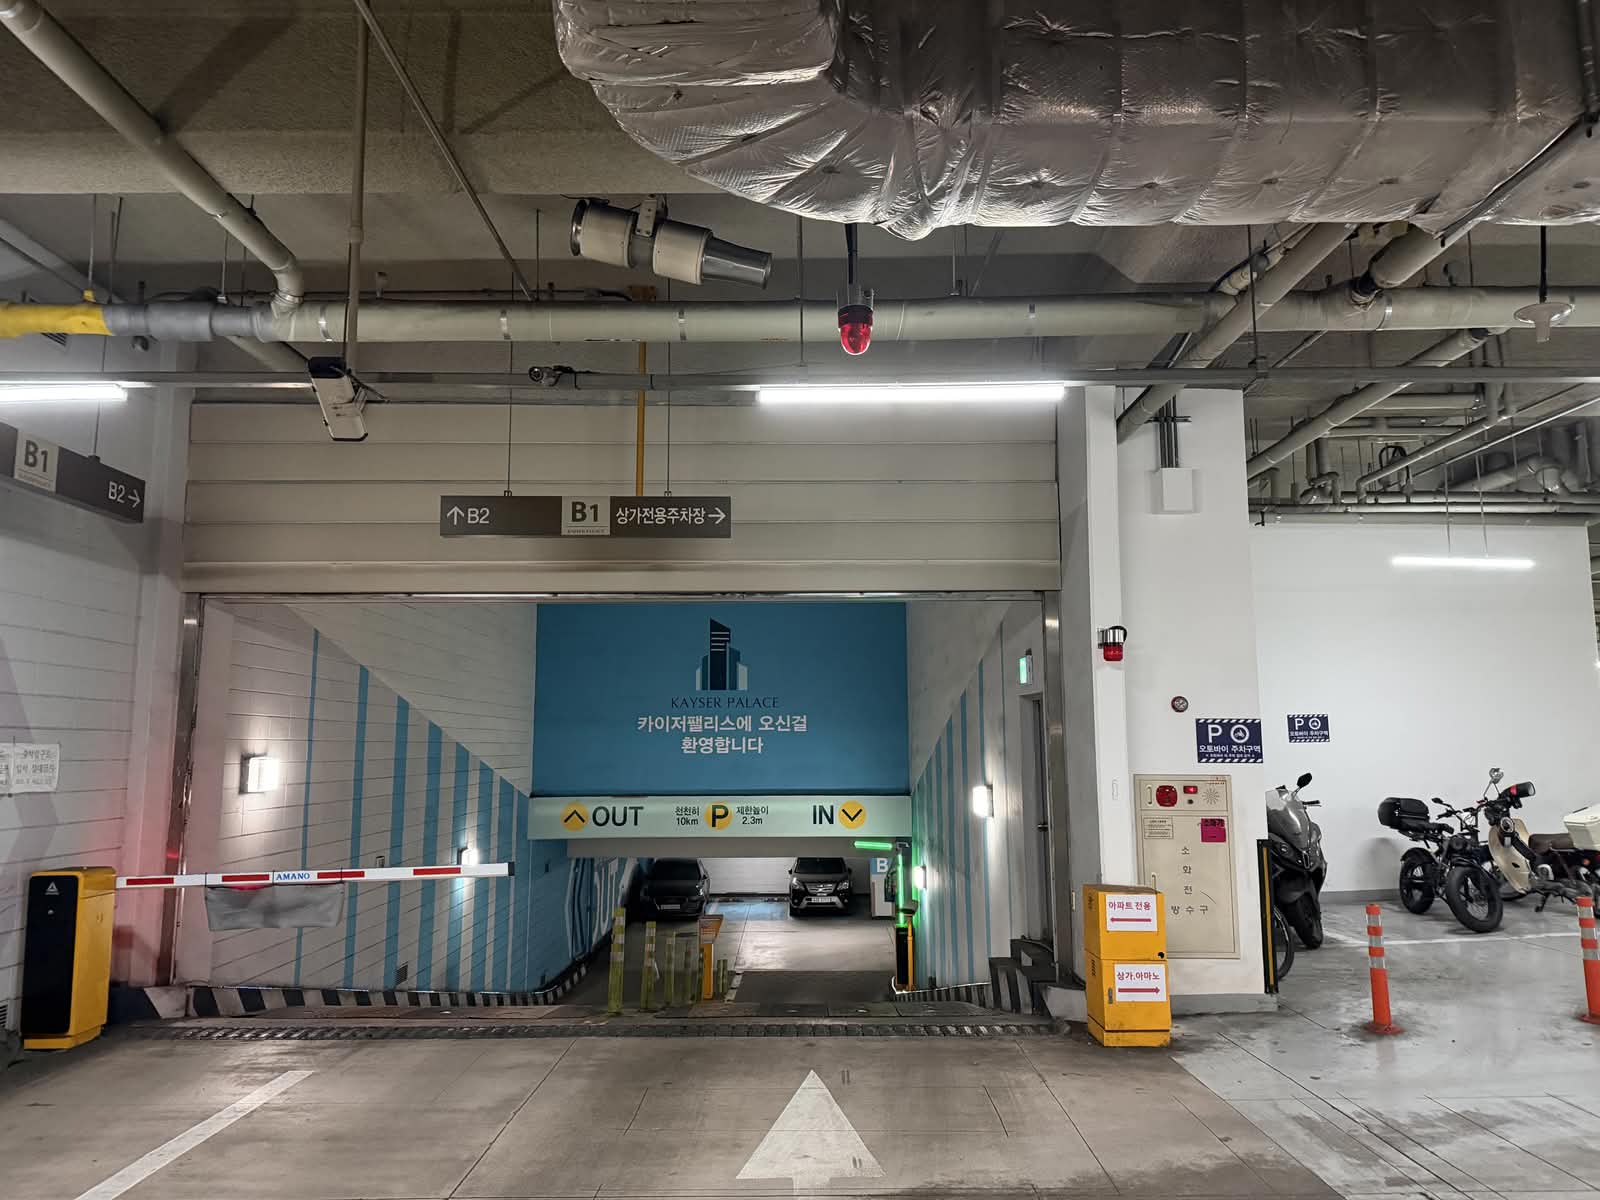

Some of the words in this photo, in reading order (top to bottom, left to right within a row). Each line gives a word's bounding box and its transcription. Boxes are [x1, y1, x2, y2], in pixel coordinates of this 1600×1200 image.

[24, 439, 48, 473] B1
[108, 481, 125, 503] B2
[467, 508, 490, 524] B2
[571, 501, 599, 522] B1
[615, 506, 706, 525] 상가전용주차장
[671, 696, 722, 709] KAYSER
[727, 696, 779, 709] PALACE
[637, 715, 752, 733] 카이저팰리스에
[758, 715, 808, 733] 오신걸
[1294, 718, 1304, 730] P
[1207, 724, 1223, 744] P
[681, 736, 764, 754] 환영합니다
[1199, 745, 1229, 753] 오토바이
[1231, 745, 1261, 754] 주차구역
[591, 806, 644, 827] OUT
[675, 806, 700, 816] 천천히
[711, 804, 729, 828] P
[736, 806, 769, 815] 제한높이
[812, 804, 835, 825] IN
[676, 817, 699, 825] 10km
[742, 816, 763, 825] 2.3m
[276, 872, 310, 881] AMANO
[1108, 901, 1133, 911] 아파트
[1135, 901, 1151, 911] 전용
